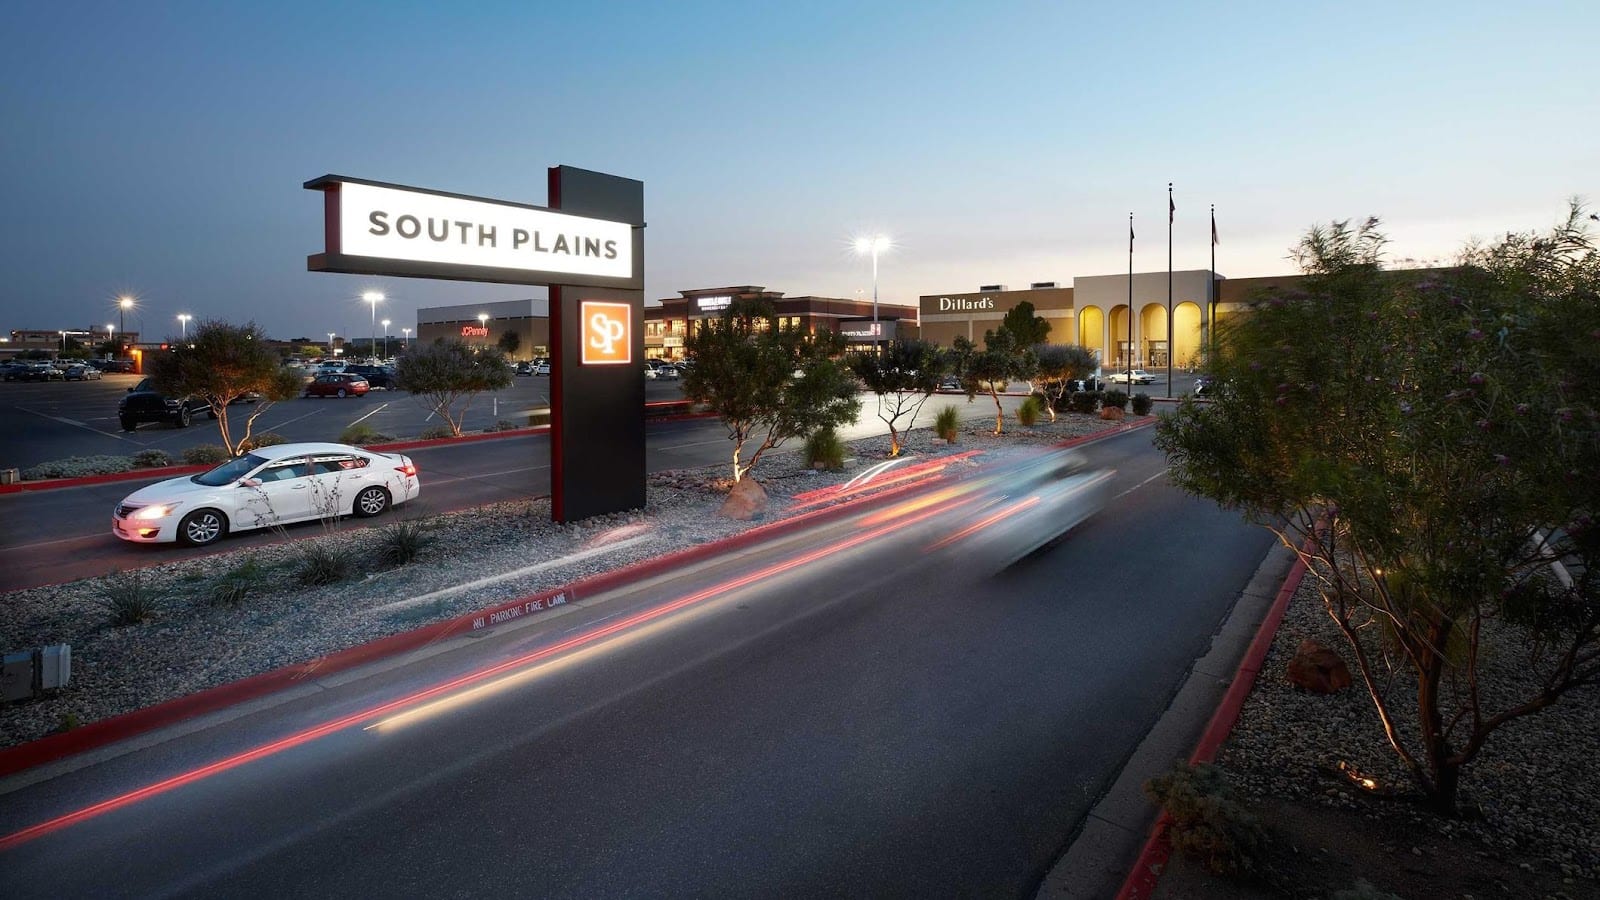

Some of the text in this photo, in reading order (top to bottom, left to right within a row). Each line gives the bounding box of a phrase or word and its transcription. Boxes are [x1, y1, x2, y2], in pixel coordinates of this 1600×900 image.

[368, 210, 618, 260] SOUTH PLAINS
[940, 297, 994, 311] Dillard's
[461, 326, 489, 337] JCPenney
[591, 313, 624, 354] SP
[473, 617, 485, 630] NO
[490, 605, 523, 624] PARKING
[525, 599, 544, 613] FIRE
